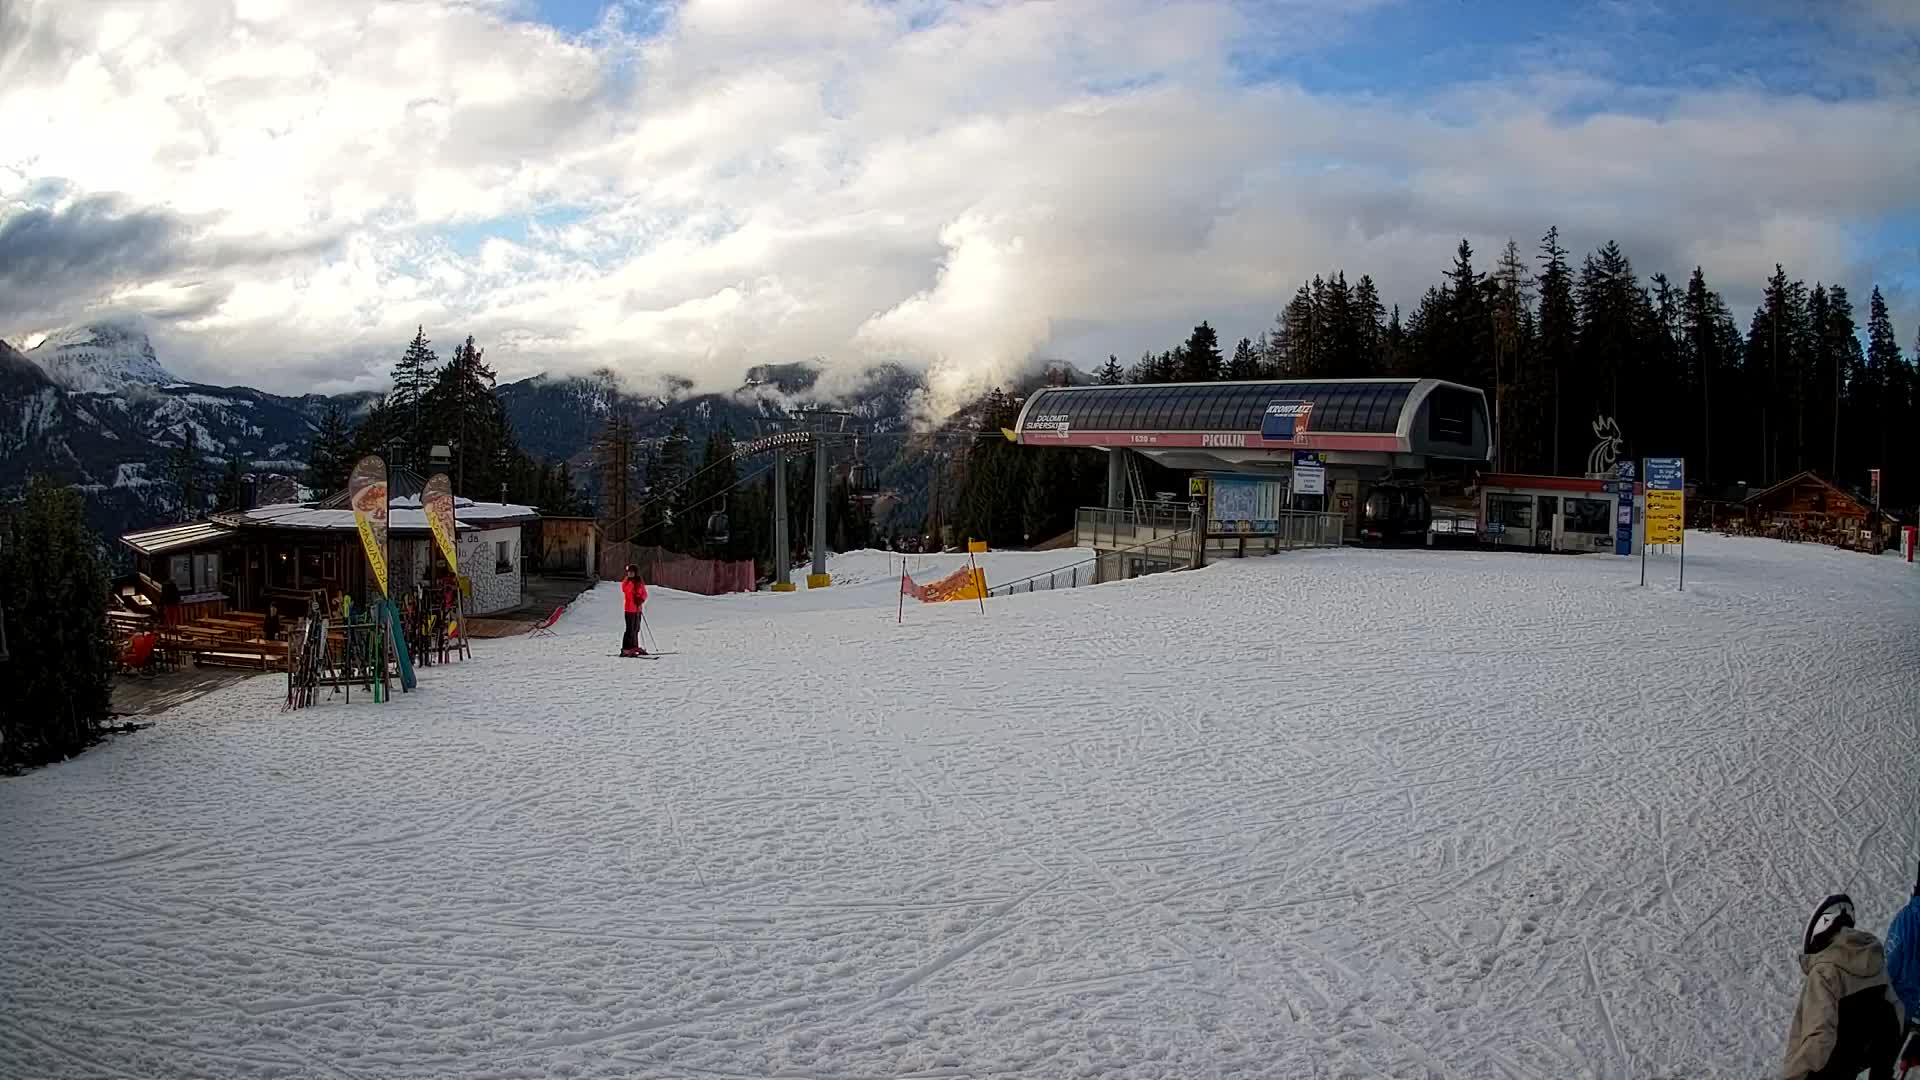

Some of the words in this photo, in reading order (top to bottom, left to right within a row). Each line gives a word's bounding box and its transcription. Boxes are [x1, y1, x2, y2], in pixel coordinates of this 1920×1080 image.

[1266, 405, 1310, 414] KRONPLATZ
[1036, 414, 1069, 422] DOLOMITI
[1026, 422, 1059, 430] SUPERSKI
[1202, 434, 1245, 447] PICULIN
